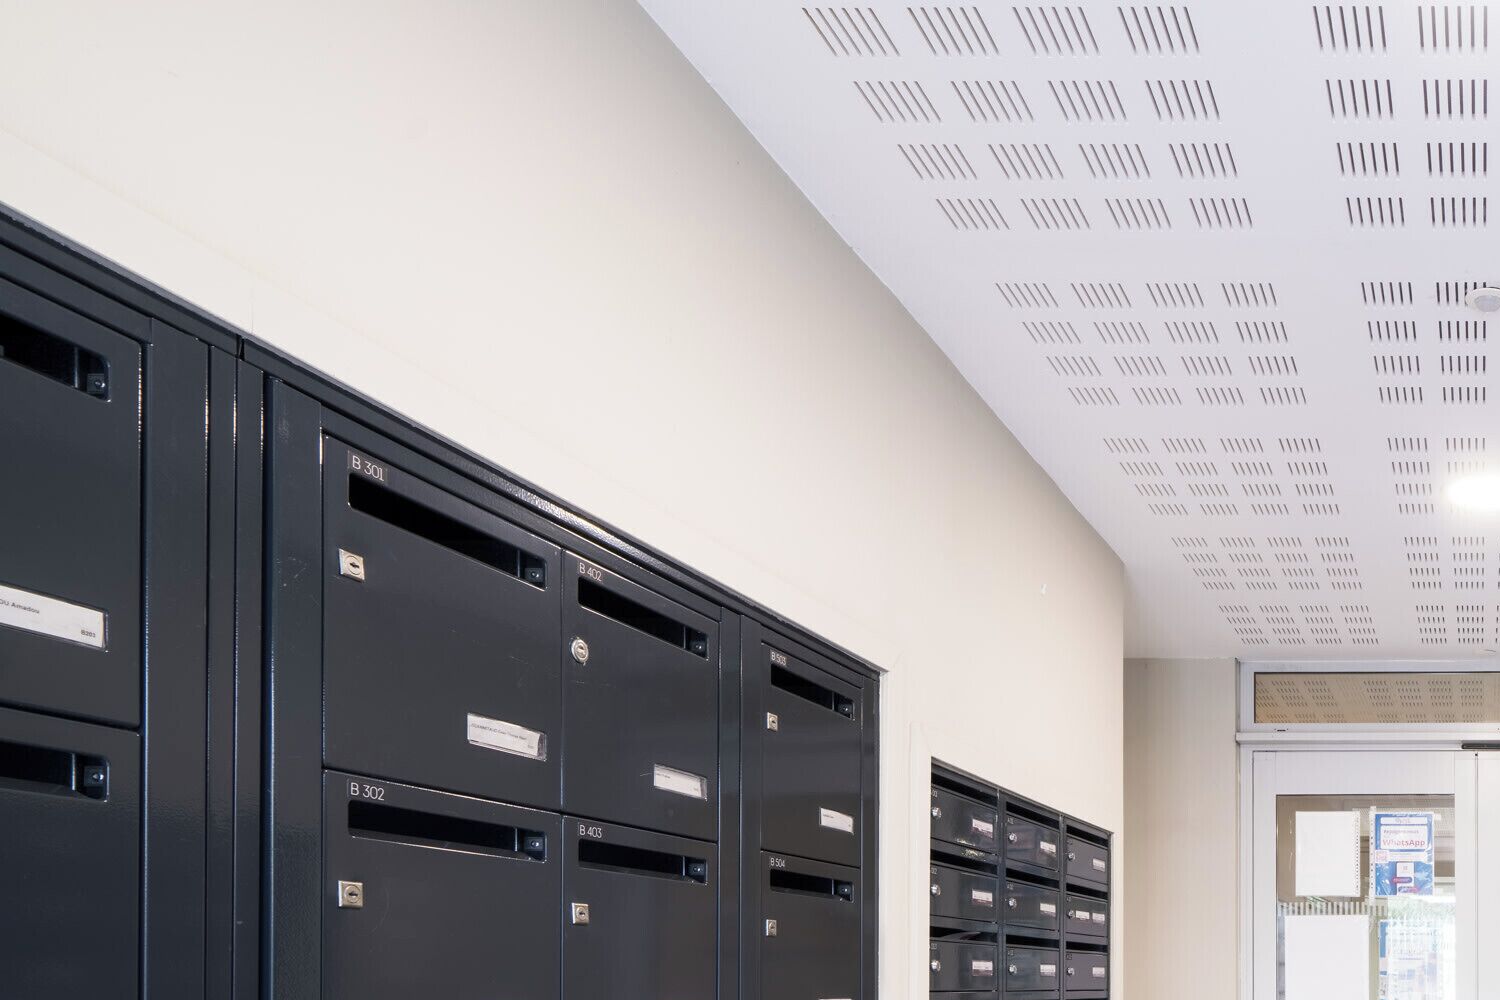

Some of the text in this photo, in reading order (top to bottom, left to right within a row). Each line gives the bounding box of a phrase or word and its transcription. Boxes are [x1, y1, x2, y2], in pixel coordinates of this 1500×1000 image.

[351, 455, 385, 481] B 301
[579, 563, 603, 581] B 402
[11, 602, 40, 614] Amadou
[350, 782, 385, 801] B 302
[579, 826, 602, 839] B 403
[1382, 838, 1426, 849] WhatsApp
